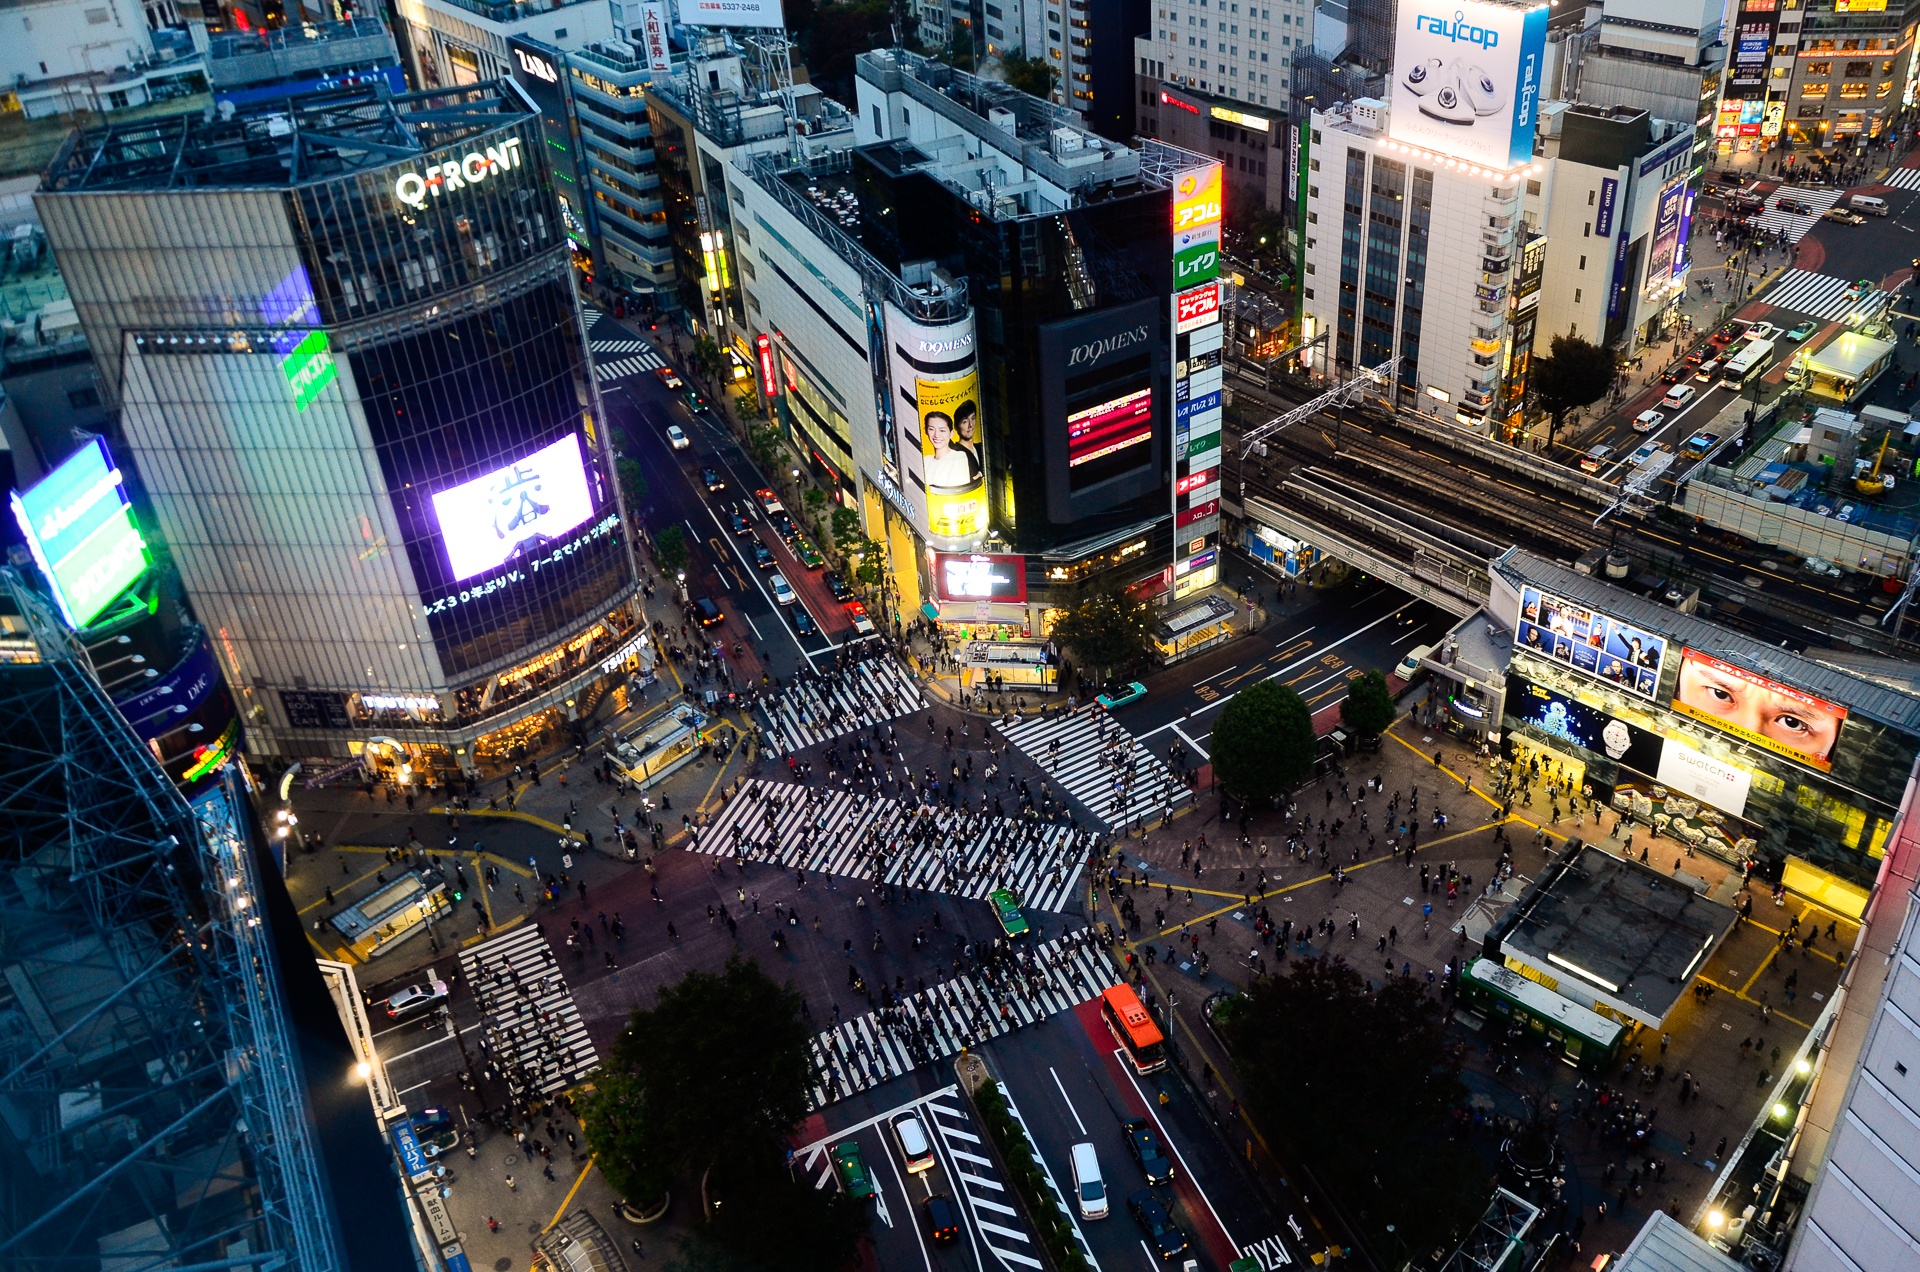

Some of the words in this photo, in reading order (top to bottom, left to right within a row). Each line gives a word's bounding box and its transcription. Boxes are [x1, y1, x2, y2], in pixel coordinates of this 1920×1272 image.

[645, 9, 664, 58] 大和証券
[1416, 10, 1499, 51] raycop
[514, 49, 559, 84] ZARA
[1518, 53, 1537, 127] raycop
[1604, 182, 1613, 207] MIZUHO
[1178, 201, 1221, 227] アコム
[1178, 251, 1216, 277] レイク
[1180, 297, 1217, 319] アイフル
[918, 382, 941, 390] Panasonic
[1189, 440, 1207, 453] レイク
[1178, 474, 1207, 491] アコム
[499, 648, 566, 687] STARBUCKS
[568, 625, 605, 653] COFFEE
[601, 634, 649, 674] TSUTAYA
[187, 672, 208, 701] DHC
[361, 695, 439, 709] TSUTAYA
[1678, 751, 1727, 780] swatch
[426, 1199, 450, 1236] 献血ルーム
